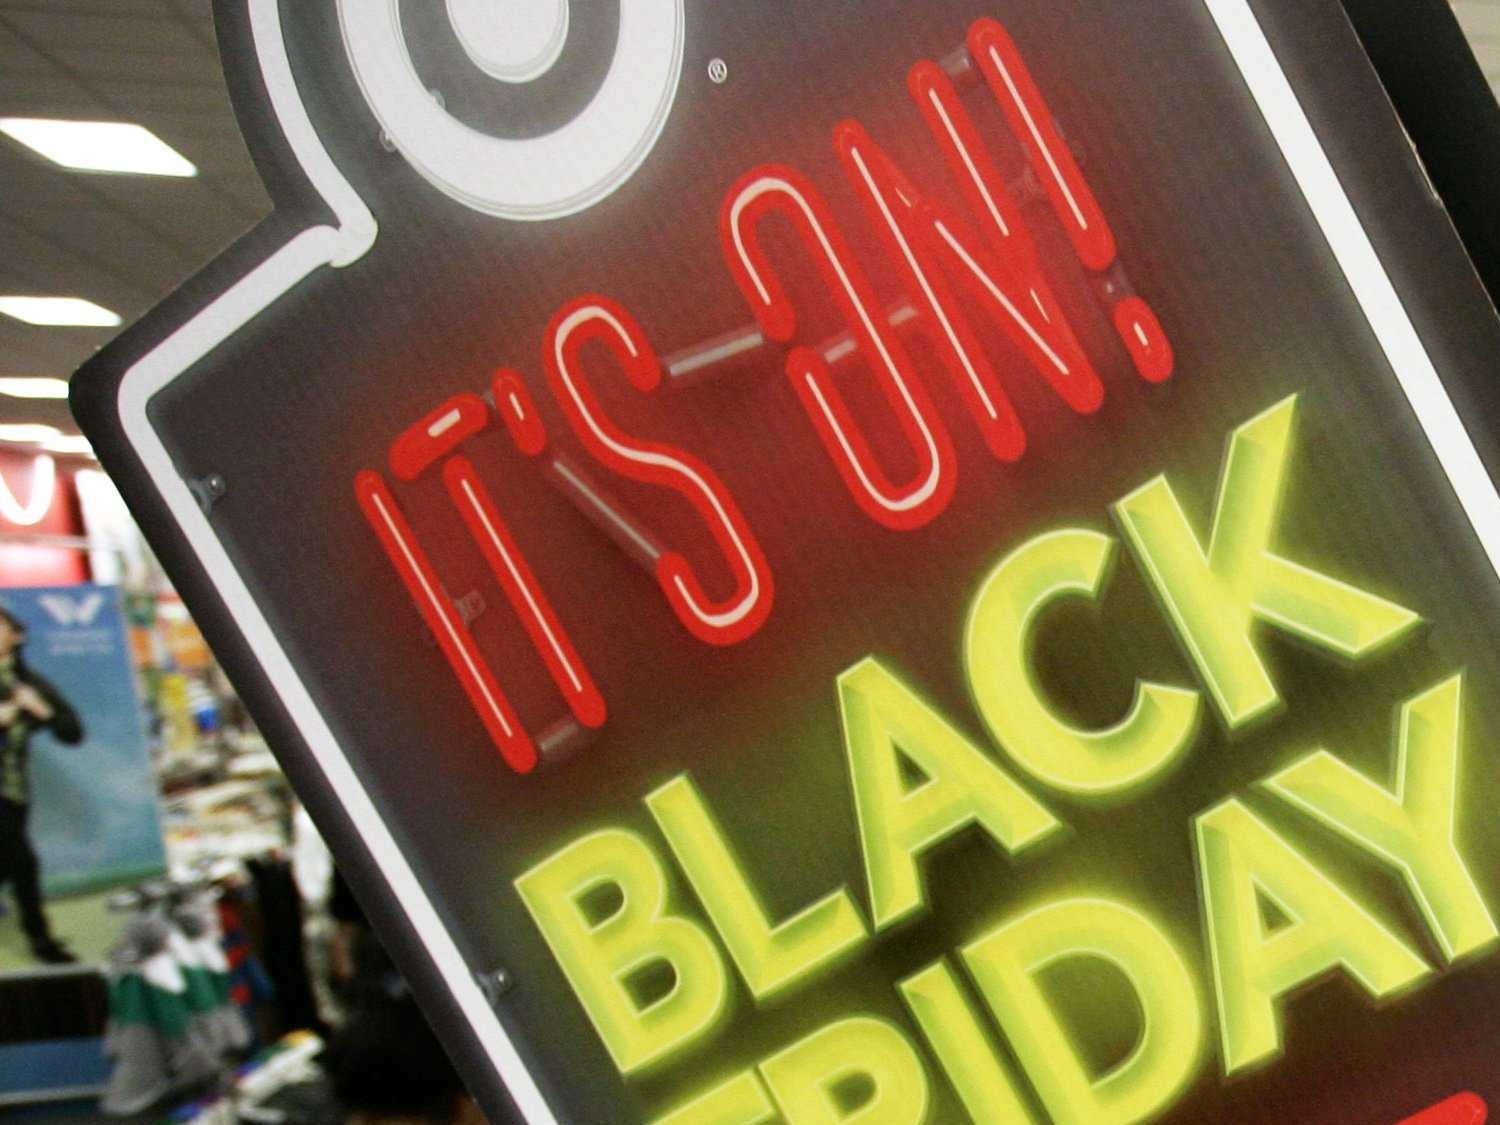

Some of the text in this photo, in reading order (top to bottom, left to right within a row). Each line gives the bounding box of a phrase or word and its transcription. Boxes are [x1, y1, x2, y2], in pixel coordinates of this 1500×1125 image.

[354, 17, 1174, 774] IT'S ON!
[512, 392, 1423, 1076] BLACK
